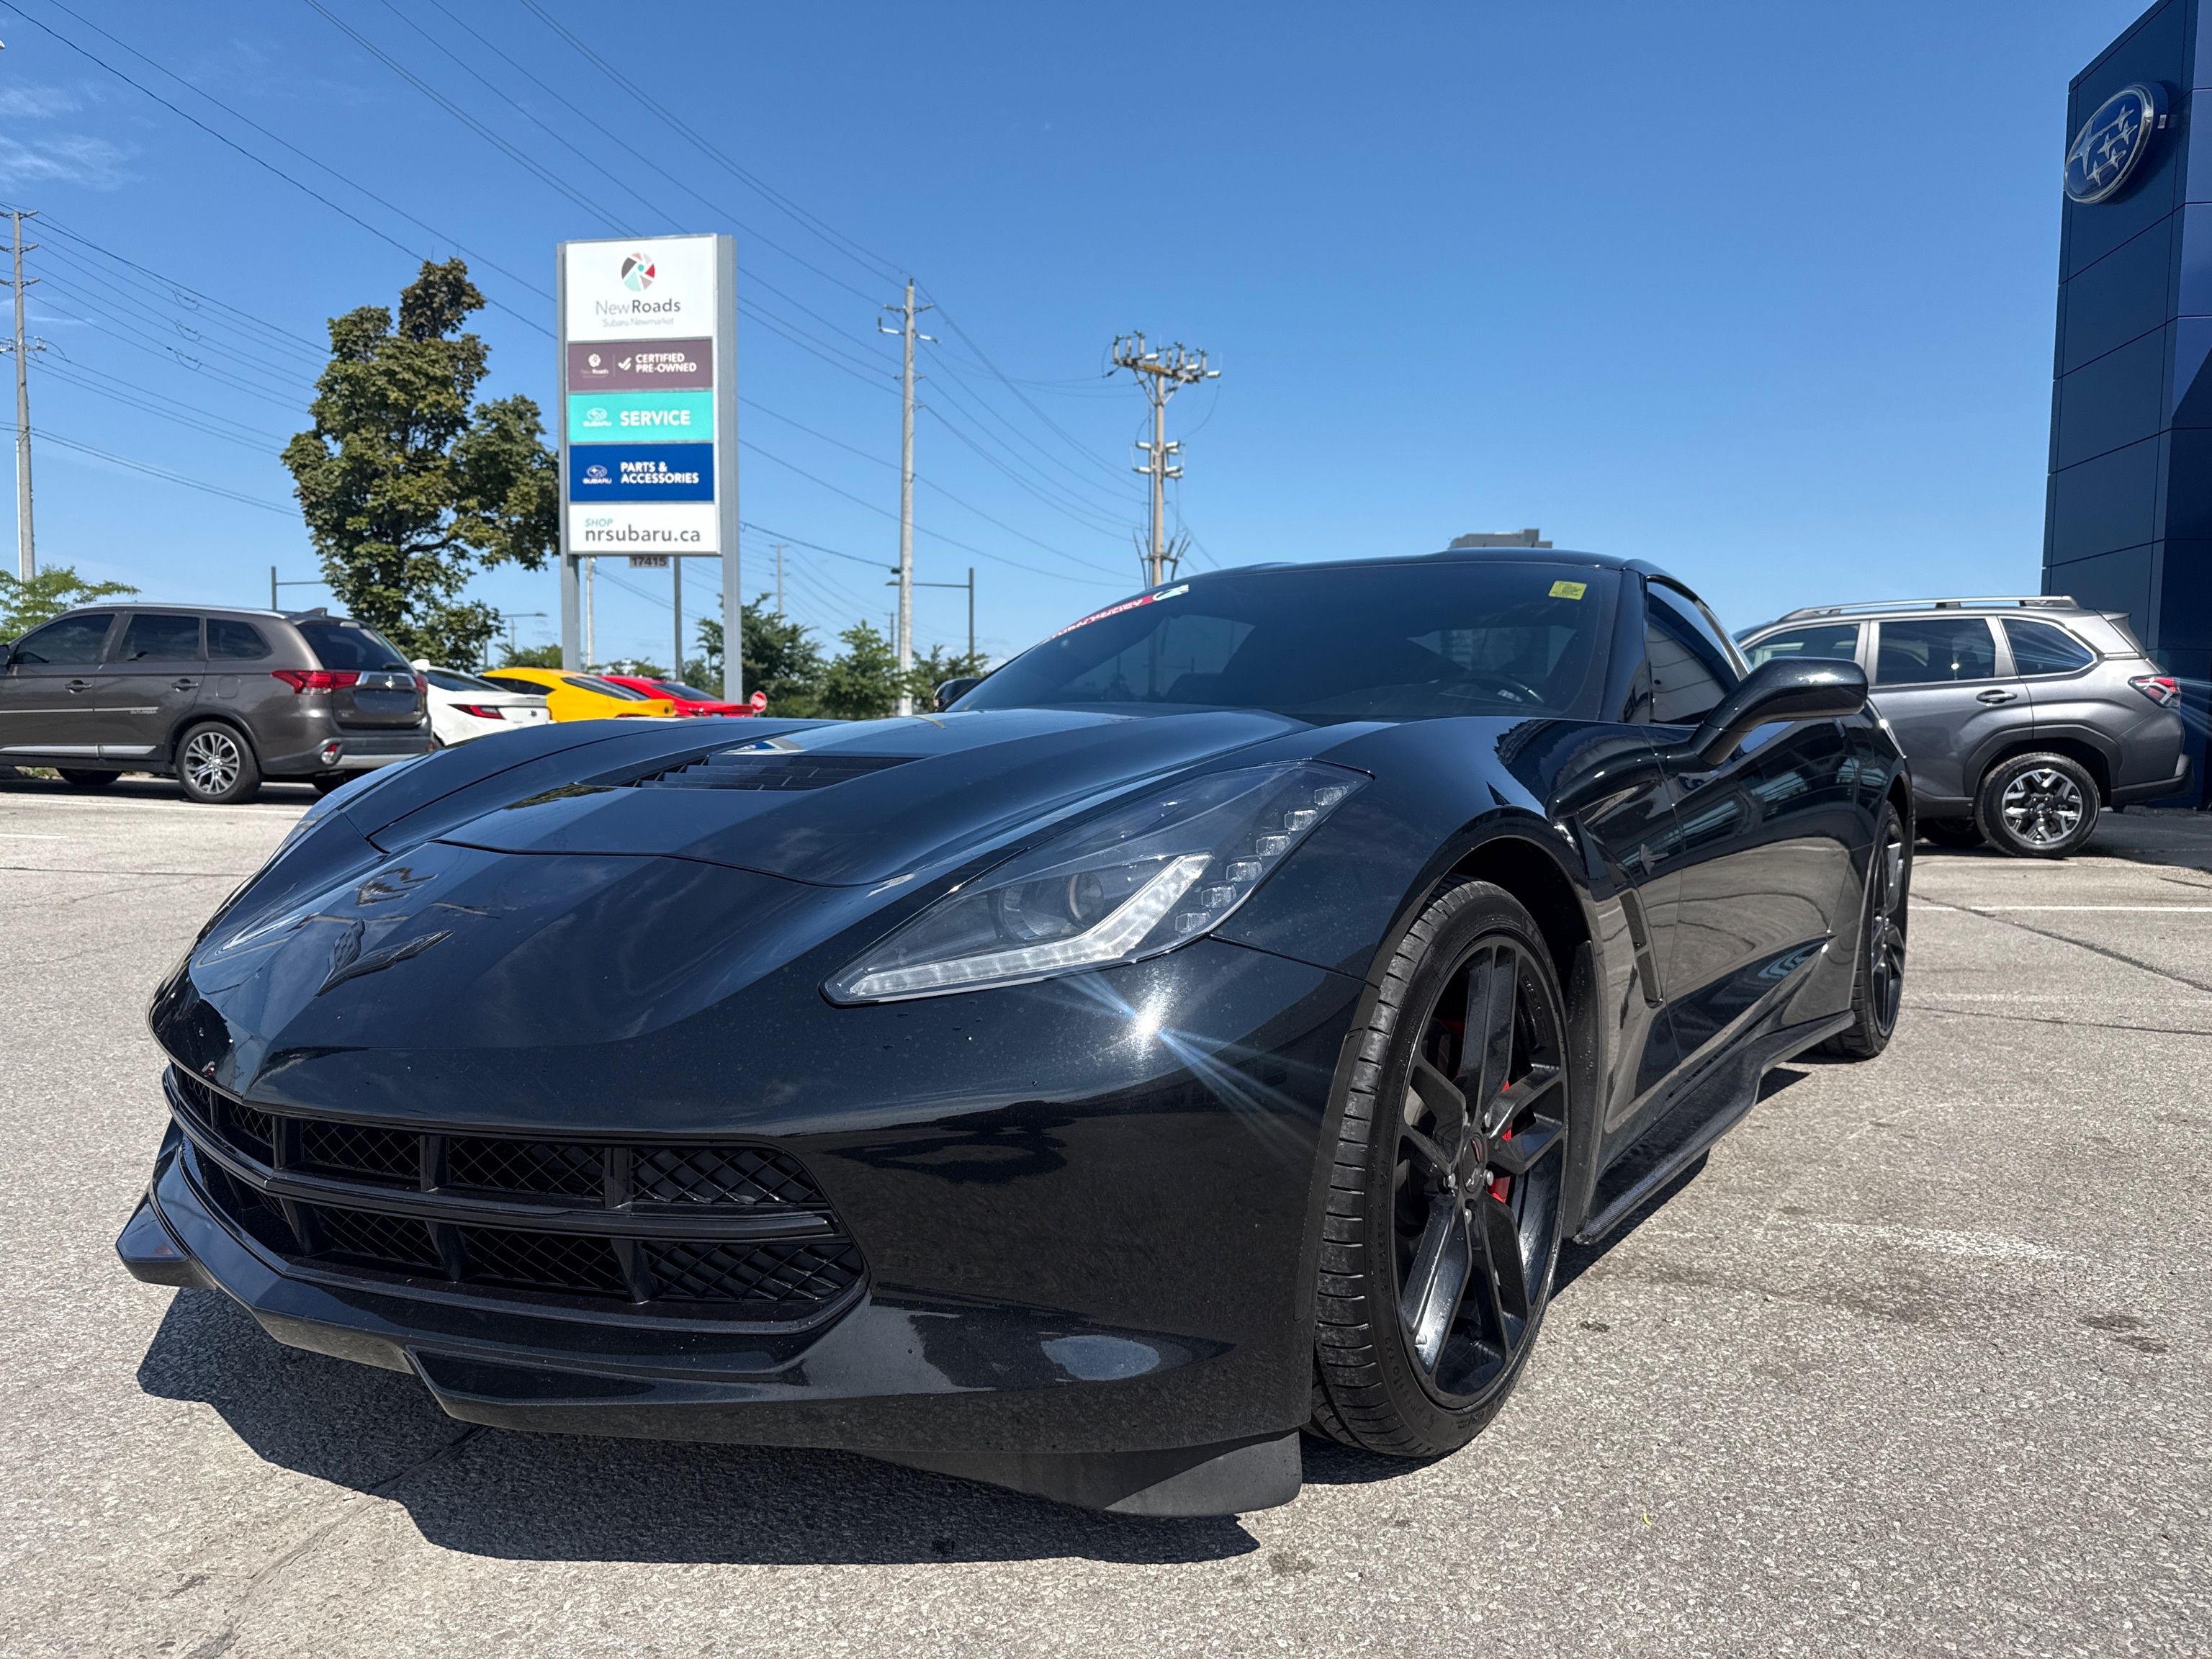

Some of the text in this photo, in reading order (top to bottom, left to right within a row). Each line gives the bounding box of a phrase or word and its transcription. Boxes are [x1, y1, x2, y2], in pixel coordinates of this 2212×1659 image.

[602, 317, 674, 328] Subaru Newmarket
[635, 352, 685, 363] CERTIFIED
[635, 362, 697, 373] PRE-OWNED
[620, 410, 691, 426] SERVICE
[620, 461, 667, 472] PARTS &
[621, 472, 699, 484] ACCESSORIES
[585, 518, 613, 527] SHOP
[585, 523, 701, 541] nrsubaru.ca
[632, 556, 667, 567] 17415
[751, 696, 766, 707] STOP
